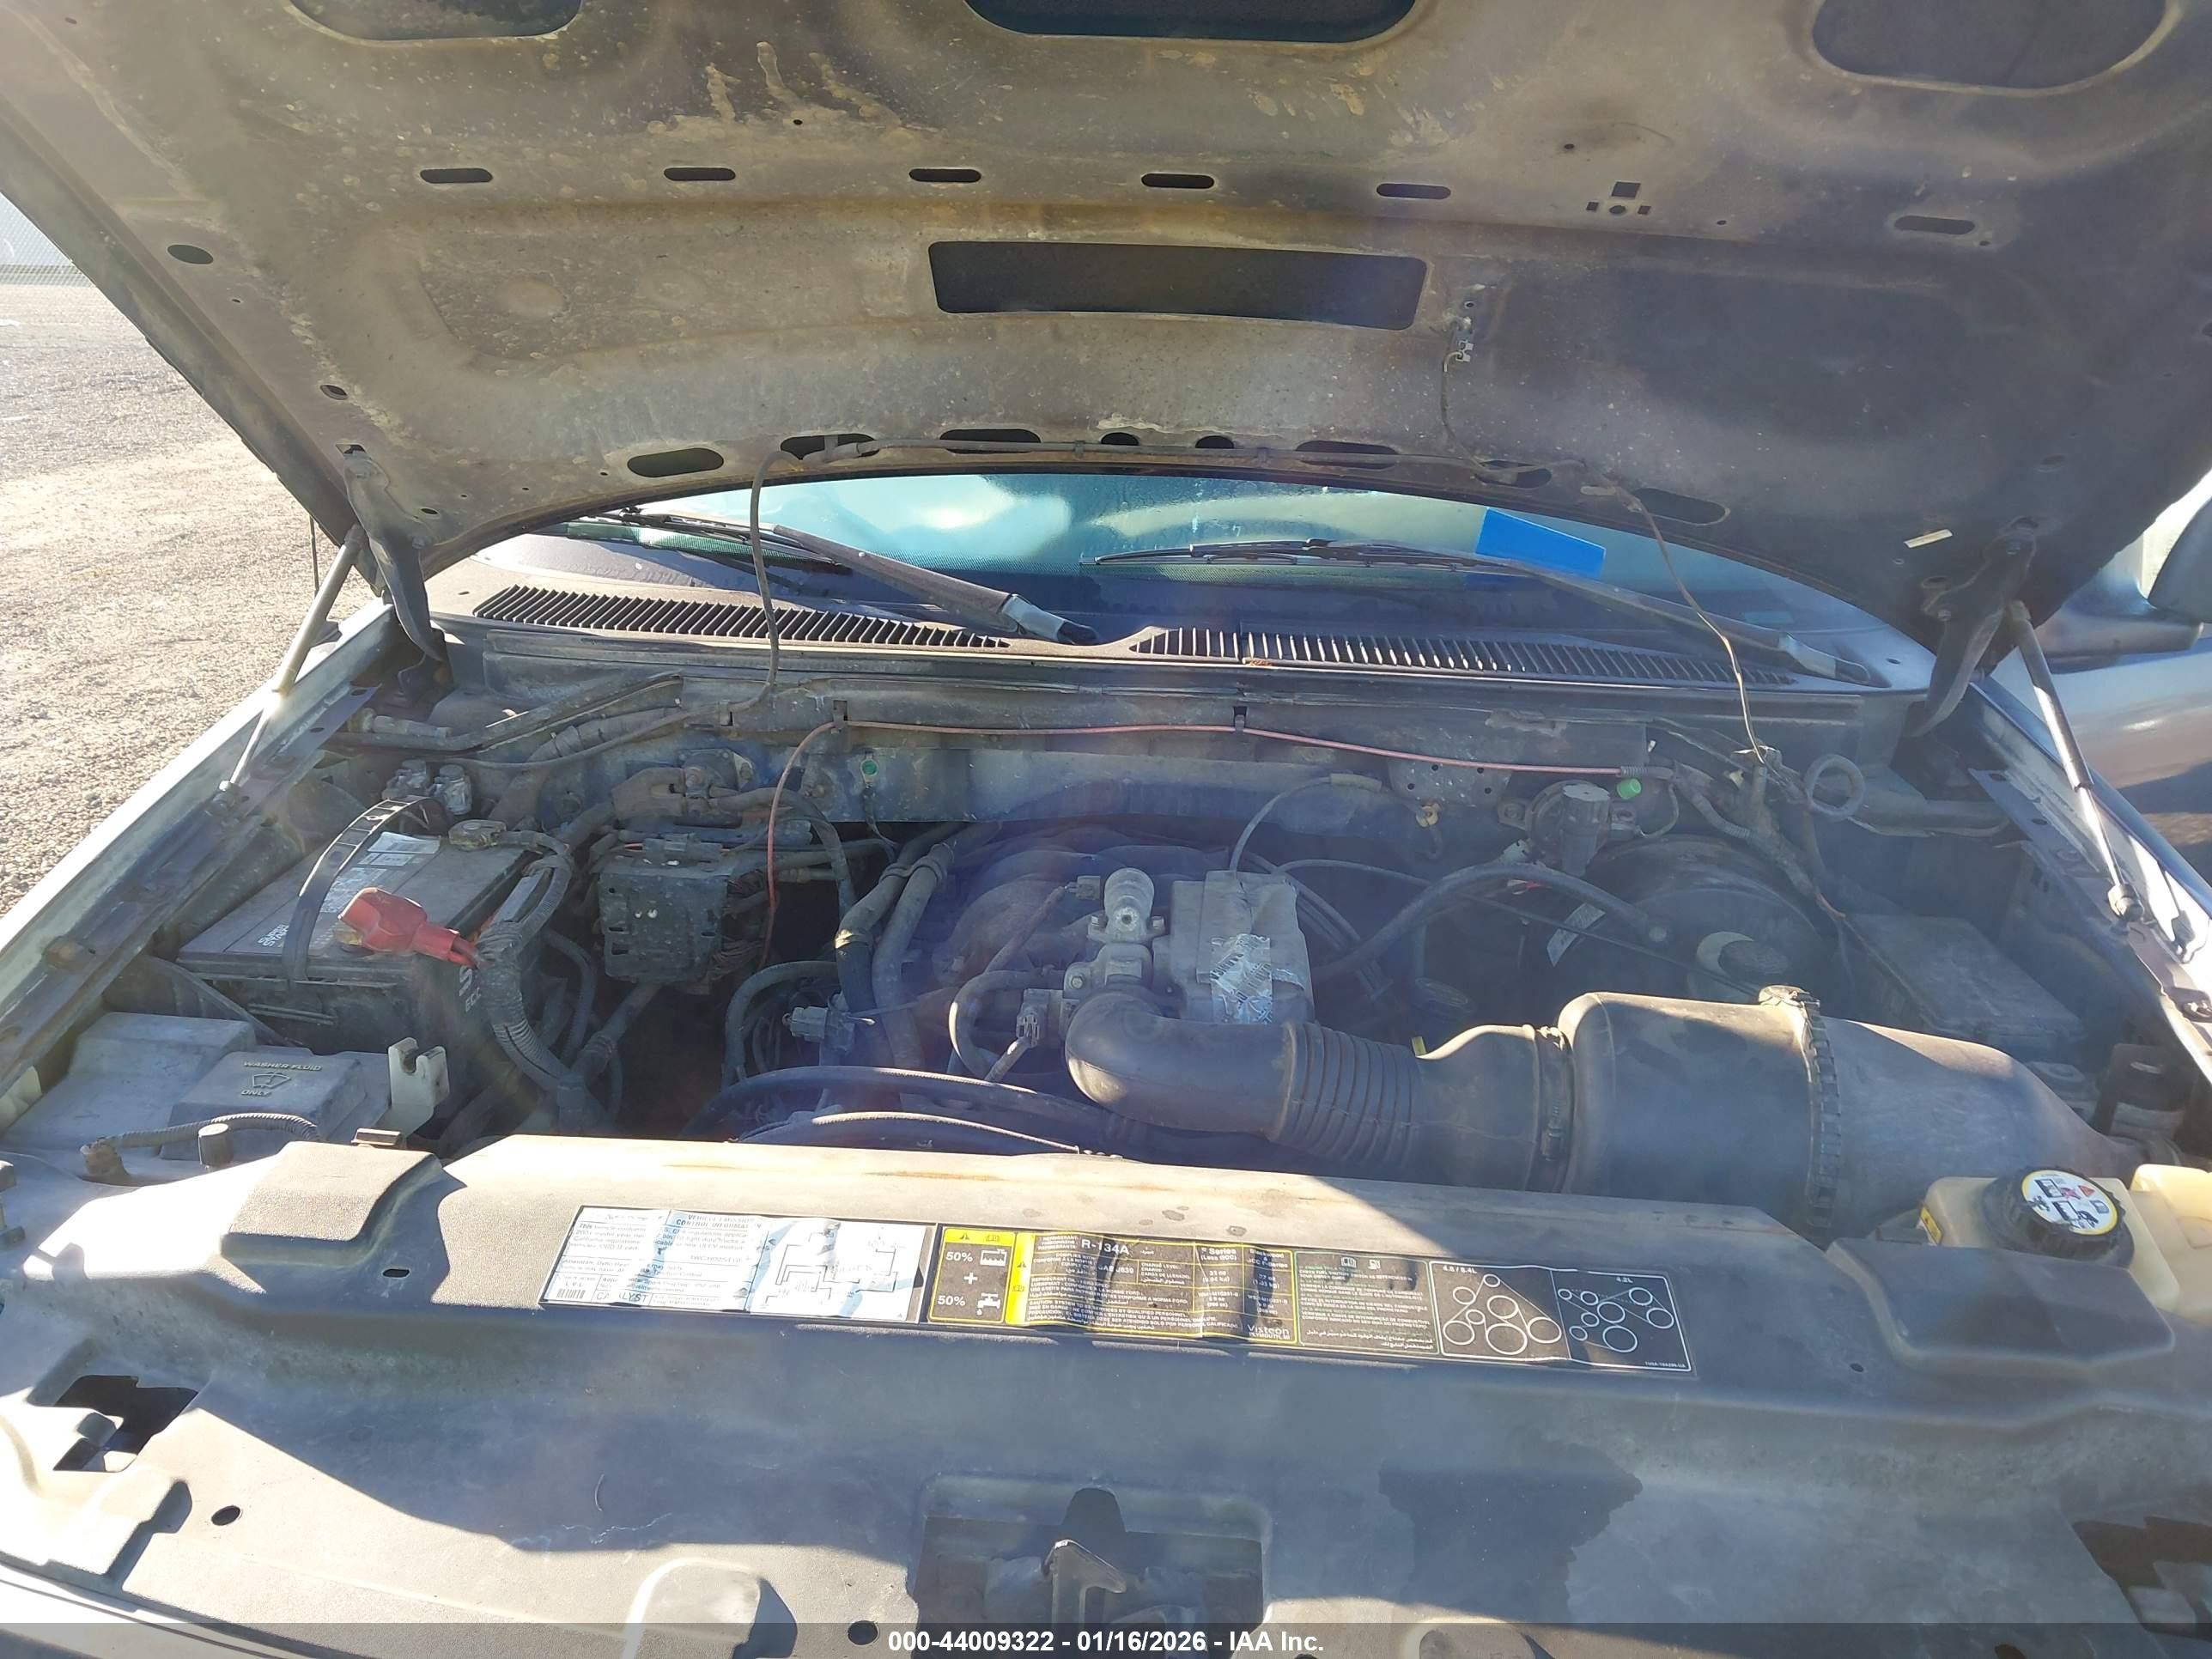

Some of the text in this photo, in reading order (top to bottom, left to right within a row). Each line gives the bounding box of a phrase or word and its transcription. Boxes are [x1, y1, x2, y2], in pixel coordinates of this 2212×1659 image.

[1081, 1238, 1130, 1255] R-134A
[945, 1251, 973, 1262] 50%
[937, 1295, 966, 1306] 50%
[1247, 1323, 1290, 1334] Visteon
